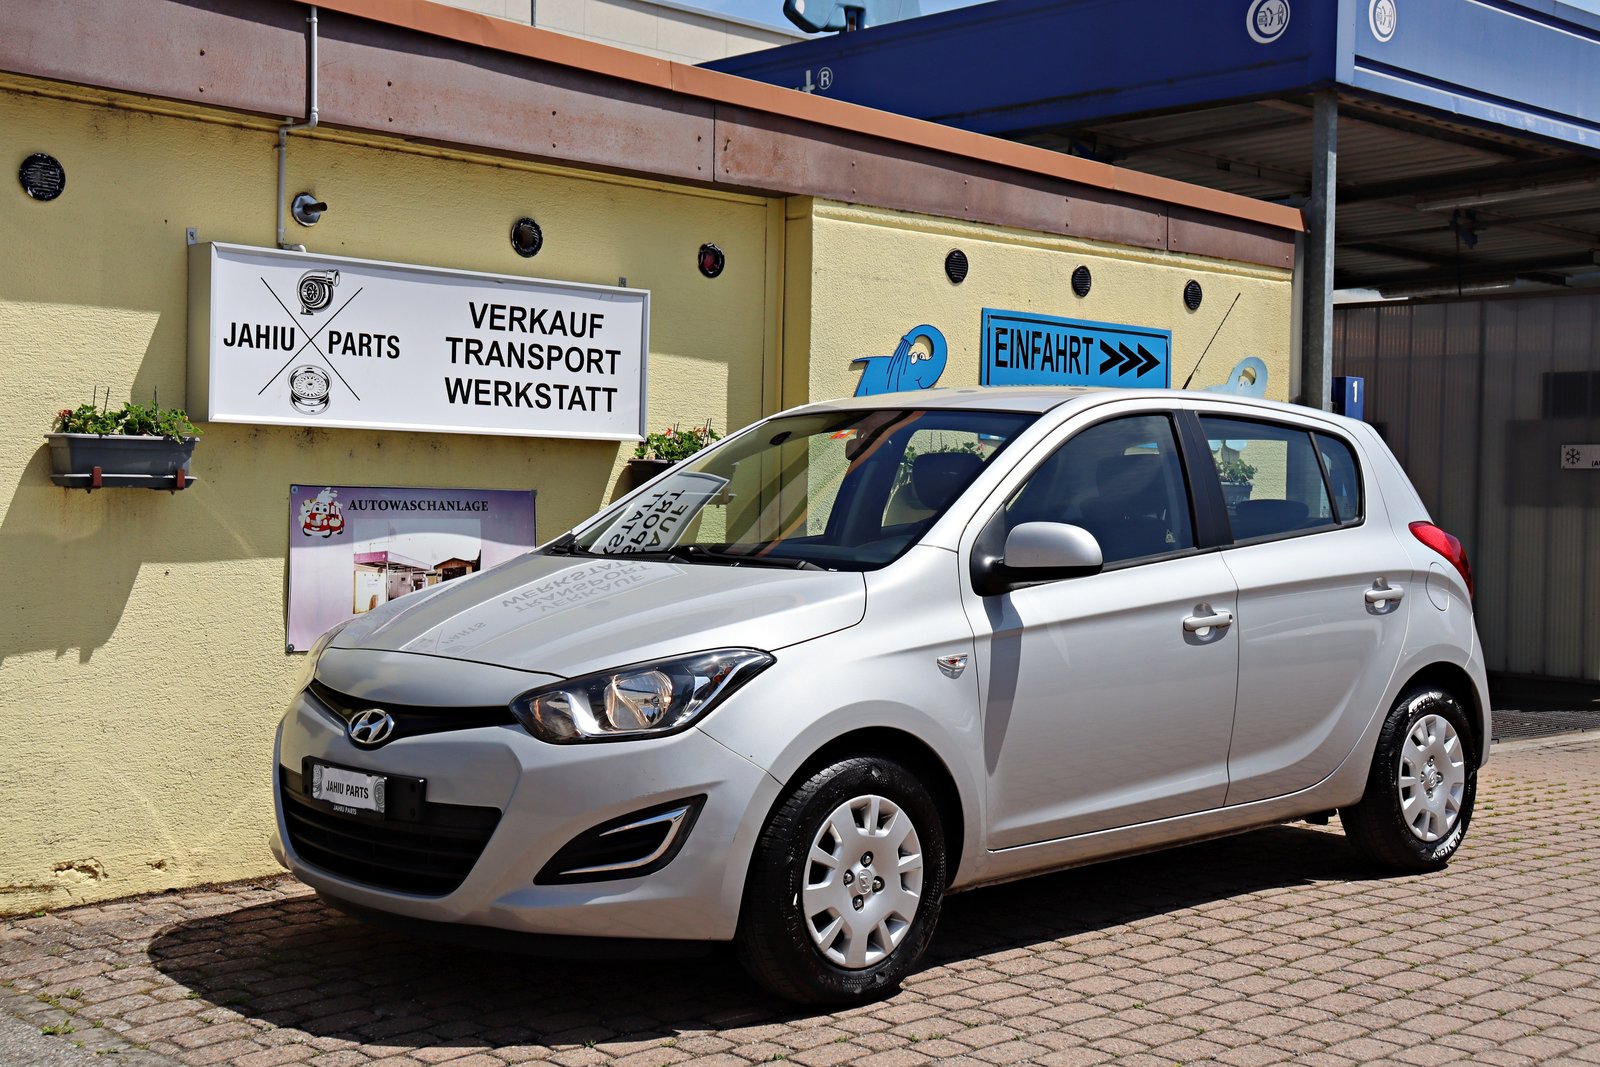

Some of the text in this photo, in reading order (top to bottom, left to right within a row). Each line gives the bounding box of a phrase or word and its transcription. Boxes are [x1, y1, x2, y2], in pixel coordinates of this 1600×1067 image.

[469, 301, 604, 339] VERKAUF
[223, 322, 400, 359] JAHIU PARTS
[445, 336, 621, 375] TRANSPORT
[995, 327, 1093, 375] EINFAHRT
[444, 377, 618, 412] WERKSTATT
[1352, 380, 1358, 403] 1
[348, 499, 489, 512] AUTOWASCHANLAGE
[326, 780, 369, 799] JAHIU PARTS
